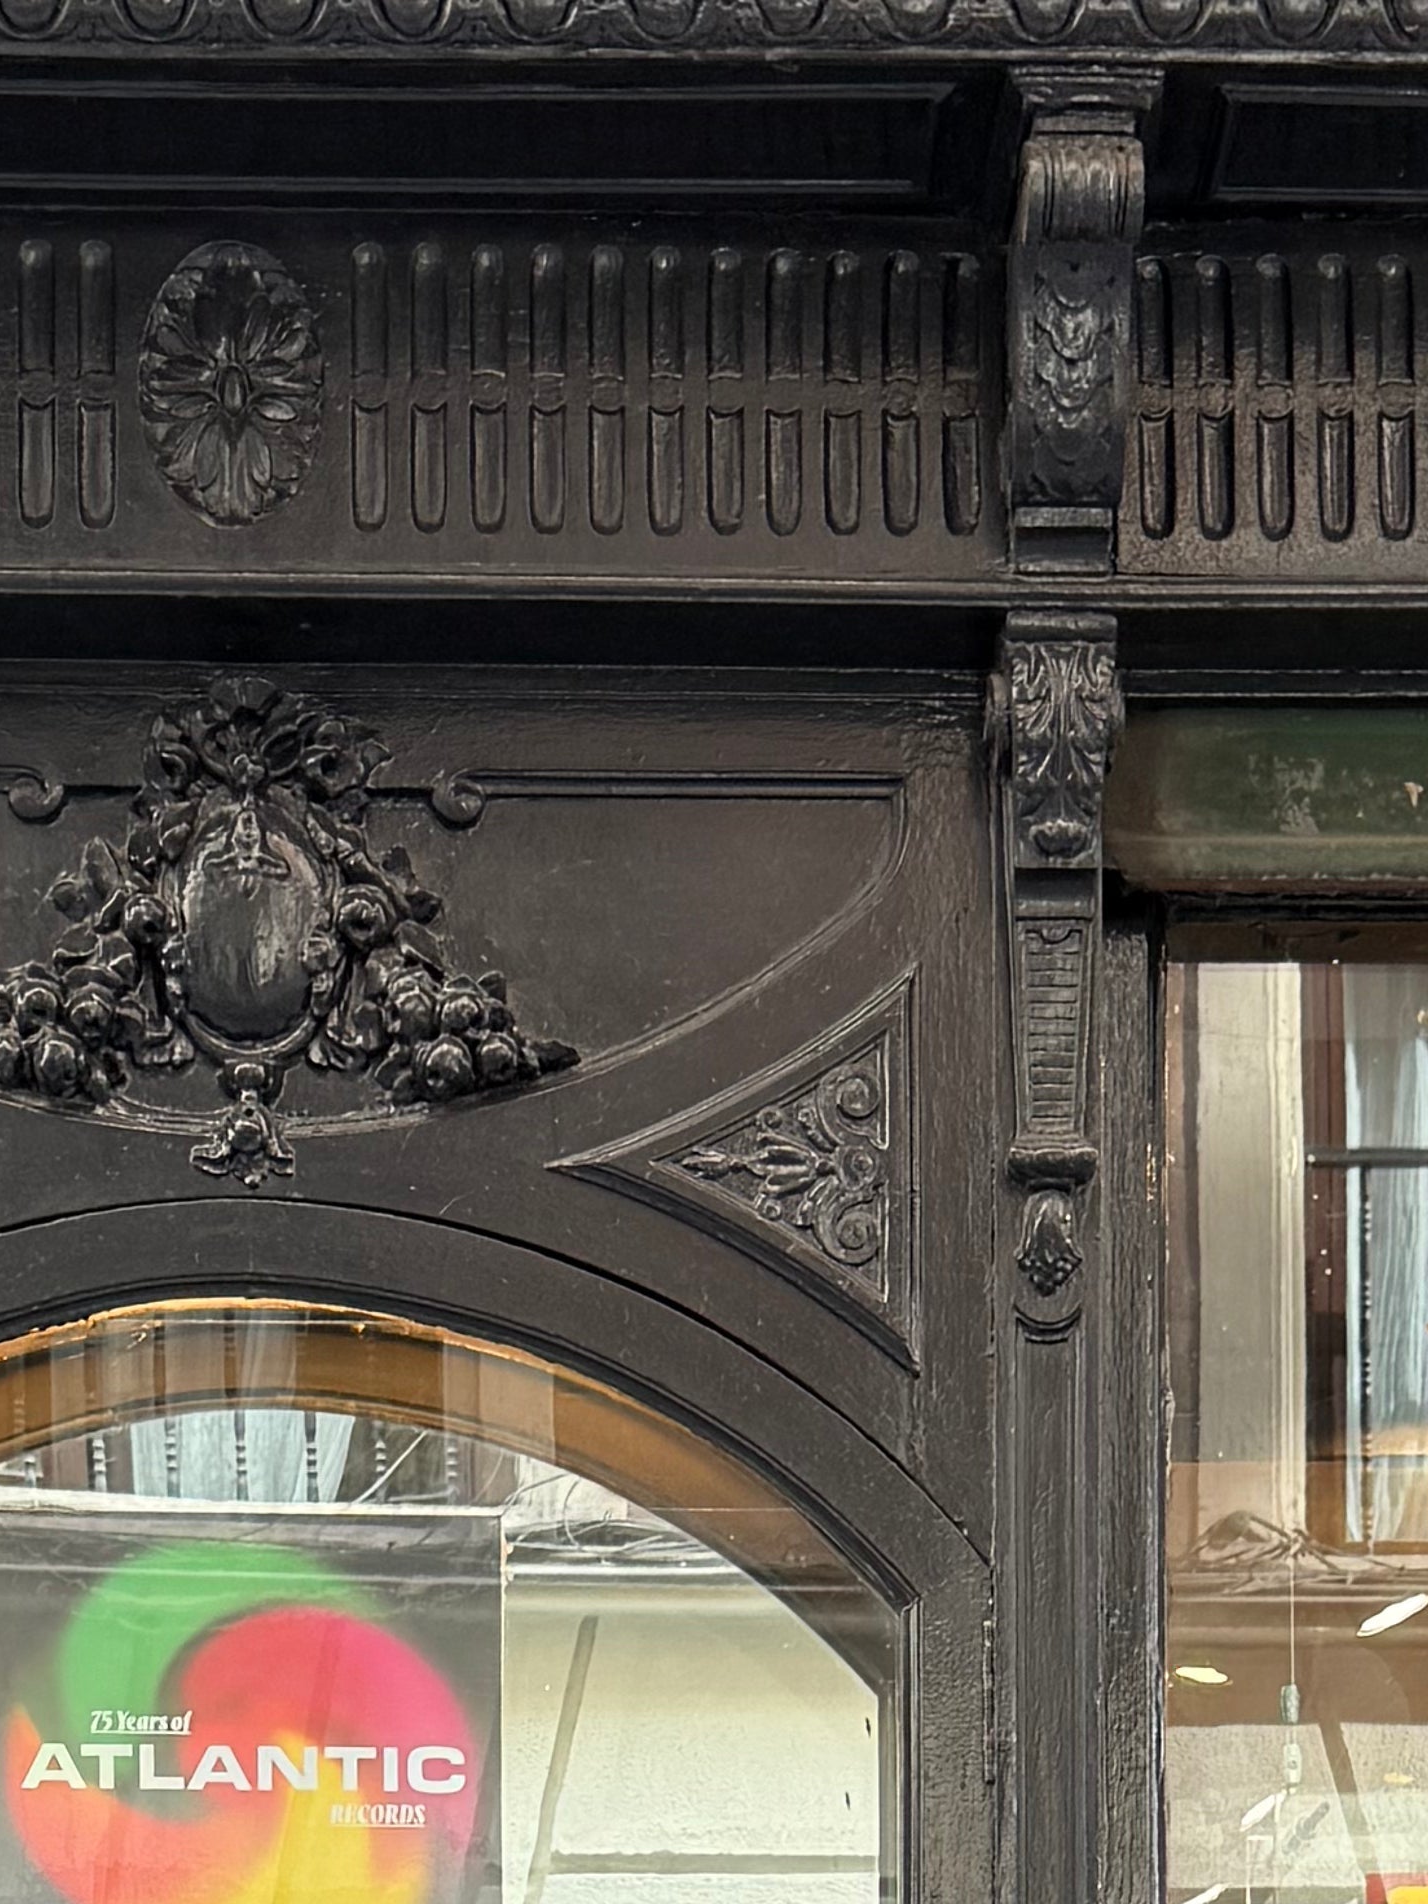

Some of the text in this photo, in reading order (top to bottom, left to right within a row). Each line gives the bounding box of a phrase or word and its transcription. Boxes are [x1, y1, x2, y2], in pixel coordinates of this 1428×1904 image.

[90, 1709, 193, 1734] 75 Years of
[20, 1742, 467, 1795] ATLANTIC
[329, 1804, 427, 1827] RECORDS
